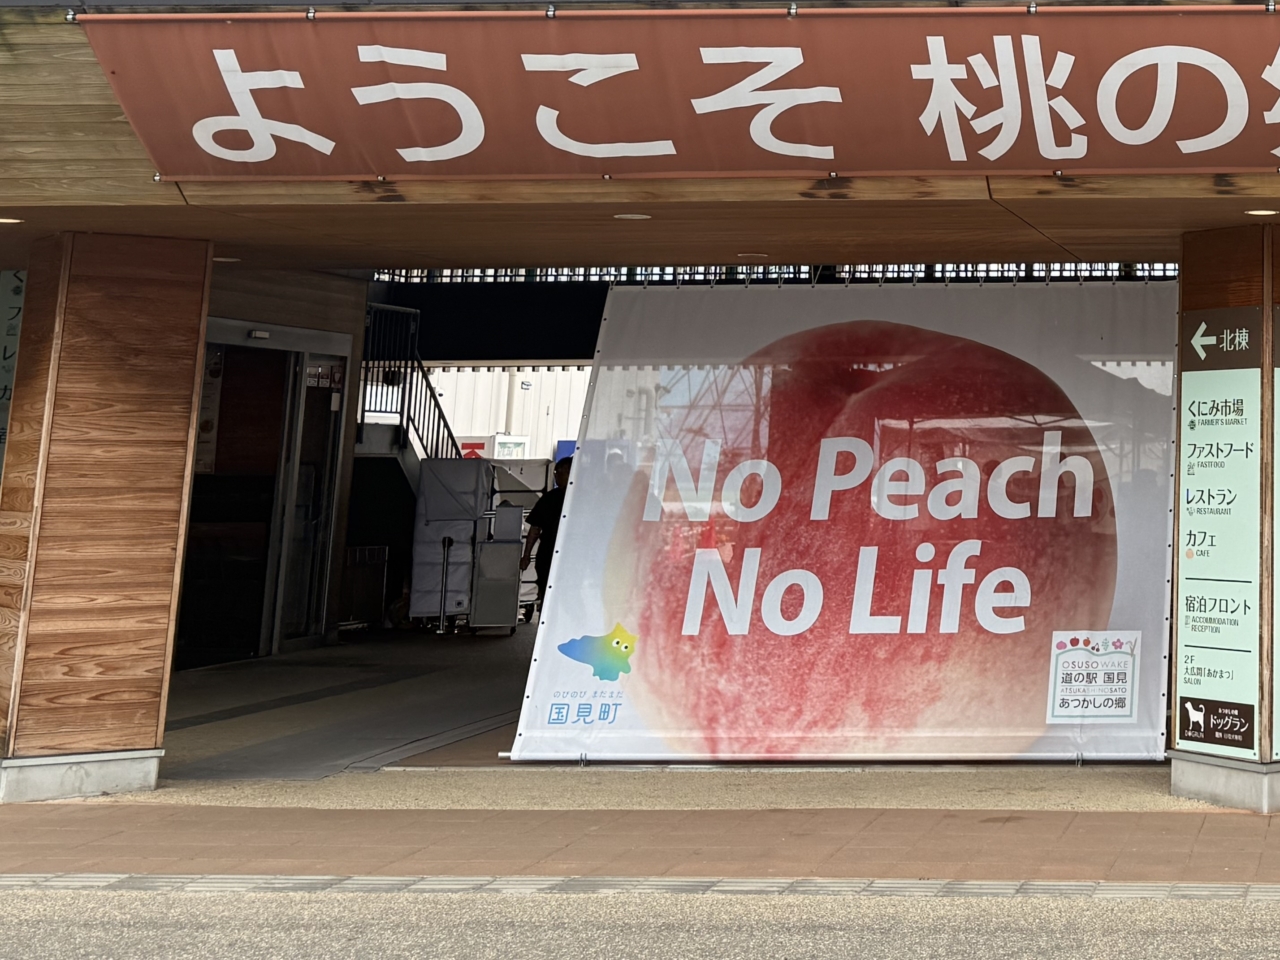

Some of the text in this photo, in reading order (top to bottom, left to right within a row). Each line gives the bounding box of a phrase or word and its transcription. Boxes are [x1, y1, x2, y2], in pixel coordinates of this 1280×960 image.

[192, 44, 842, 162] ようこそ
[1219, 328, 1250, 351] 北棟
[1188, 399, 1245, 417] くにみ市場
[1198, 418, 1248, 427] FARMER'S MARKET
[1187, 442, 1255, 459] ファストフード
[642, 430, 1095, 522] No Peach
[1186, 488, 1237, 506] レストラン
[1196, 507, 1232, 516] RESTAURANT
[1186, 529, 1217, 547] カフェ
[1195, 549, 1210, 557] CAFE
[681, 540, 1032, 636] No Life
[1185, 595, 1251, 616] 宿泊フロント
[1191, 616, 1239, 627] ACCOMMODATION
[1191, 624, 1221, 634] RECEPTION
[1062, 661, 1129, 669] OSUSOWAKE
[1184, 654, 1196, 664] 2F
[1061, 672, 1128, 684] 道の駅 国見
[1183, 677, 1202, 686] SALON
[553, 690, 588, 699] のびのび
[1059, 697, 1127, 709] あつかしの郷
[547, 703, 623, 725] 国見町
[1210, 714, 1250, 733] ドッグラン
